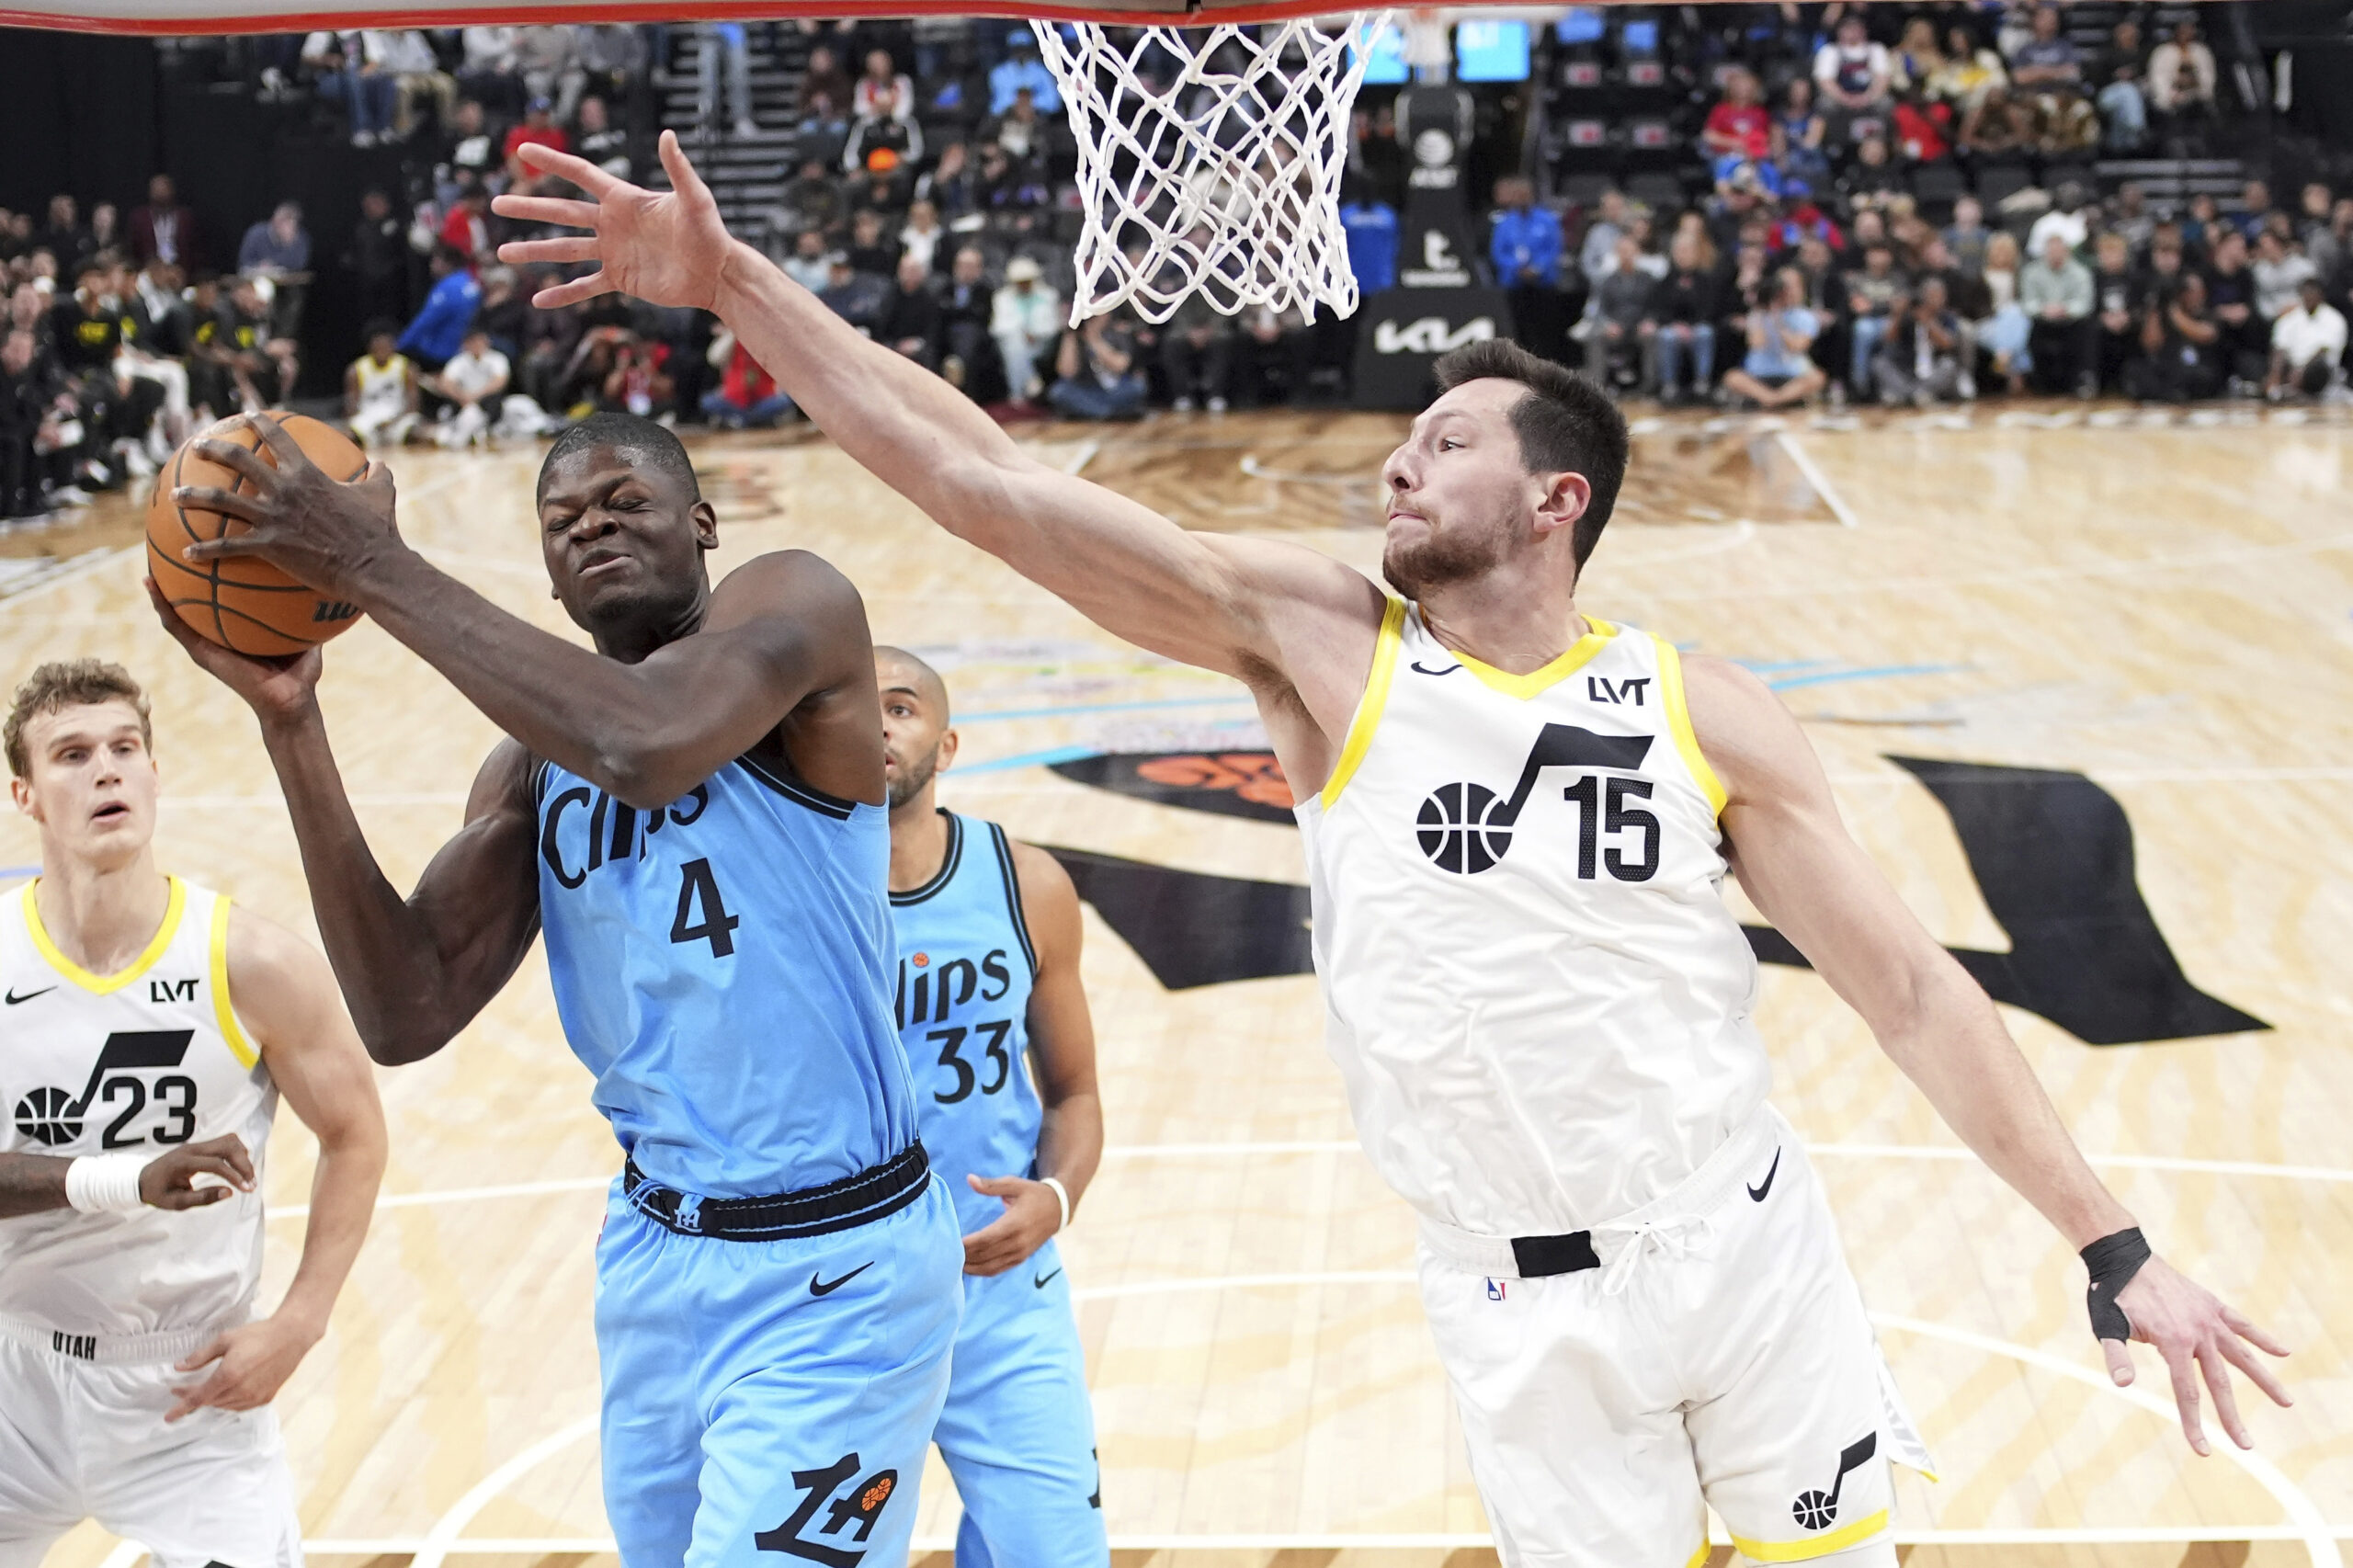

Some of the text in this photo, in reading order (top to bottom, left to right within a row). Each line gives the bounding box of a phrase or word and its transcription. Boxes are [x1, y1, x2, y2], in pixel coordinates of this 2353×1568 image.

[1587, 676, 1651, 706] LVT
[1563, 776, 1661, 882] 15
[670, 858, 739, 959] 4
[150, 979, 199, 1003] LVT
[894, 949, 1010, 1032] lips
[926, 1019, 1012, 1104] 33
[102, 1075, 197, 1150] 23
[52, 1330, 97, 1361] UTAH
[755, 1452, 898, 1568] LA
